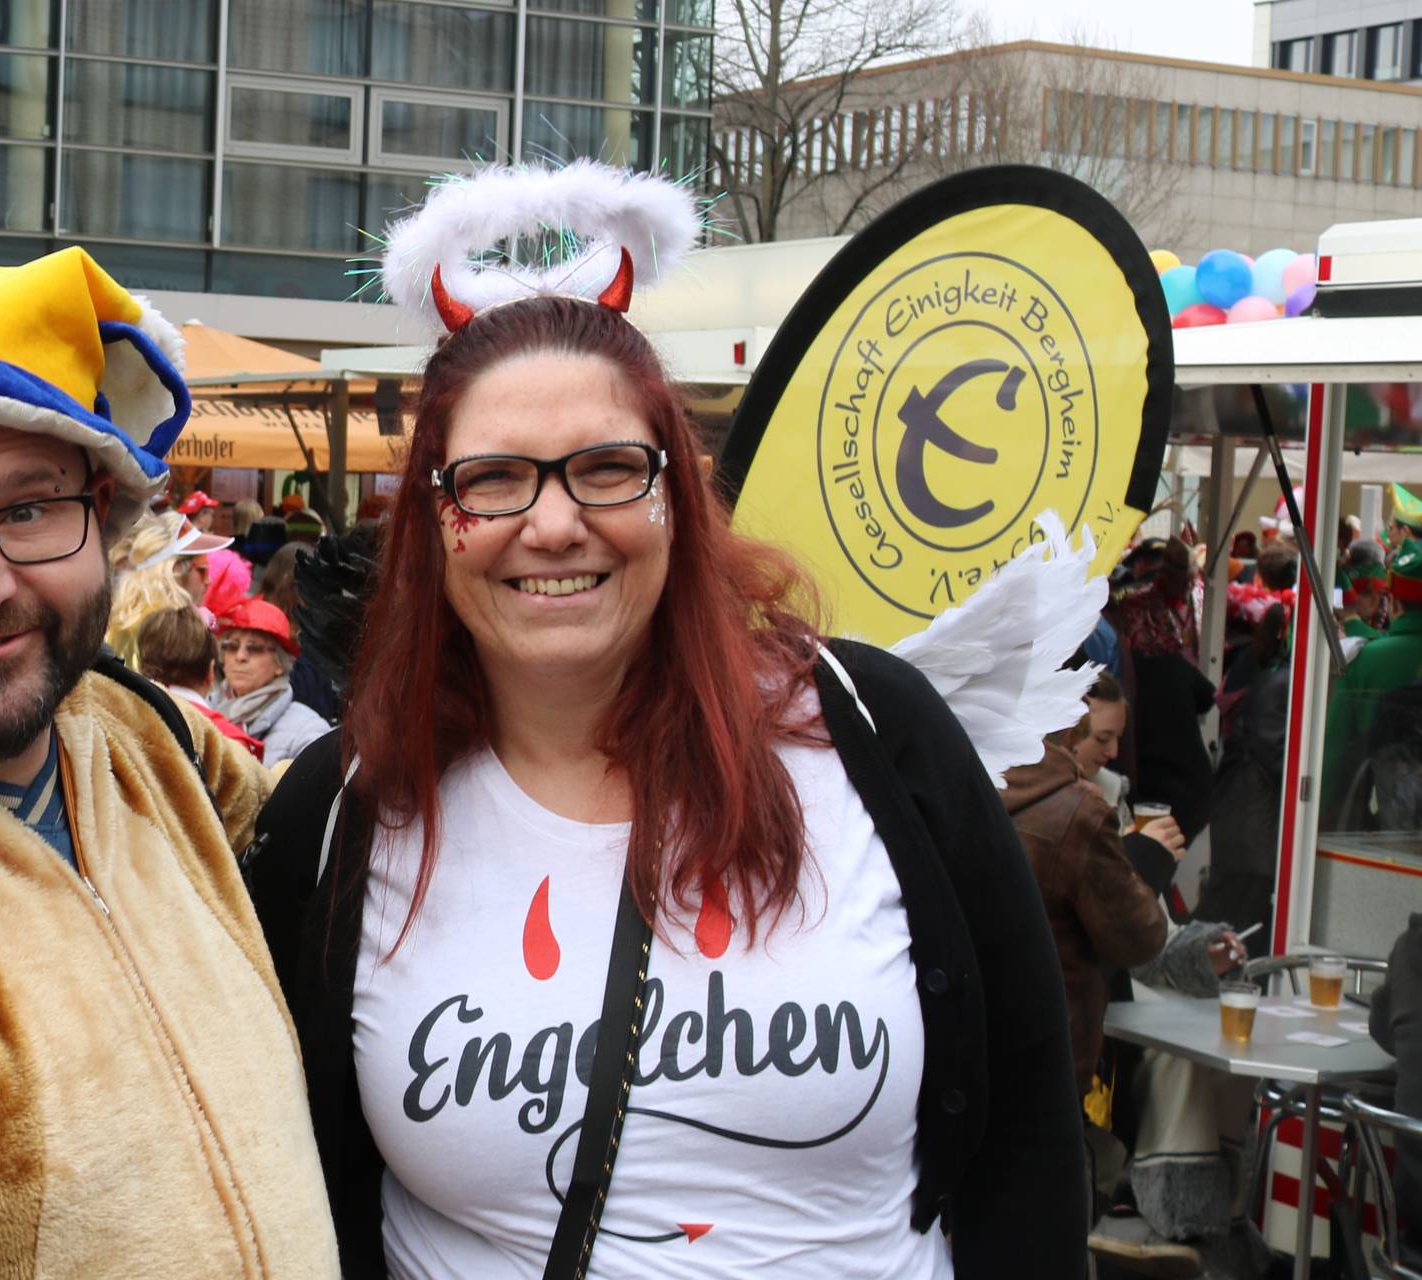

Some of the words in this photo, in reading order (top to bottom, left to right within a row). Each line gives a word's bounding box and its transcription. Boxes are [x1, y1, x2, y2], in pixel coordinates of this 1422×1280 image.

[832, 338, 903, 569] Gesellschaft
[885, 269, 1019, 338] Einigkeit
[1020, 296, 1084, 480] Bergheim
